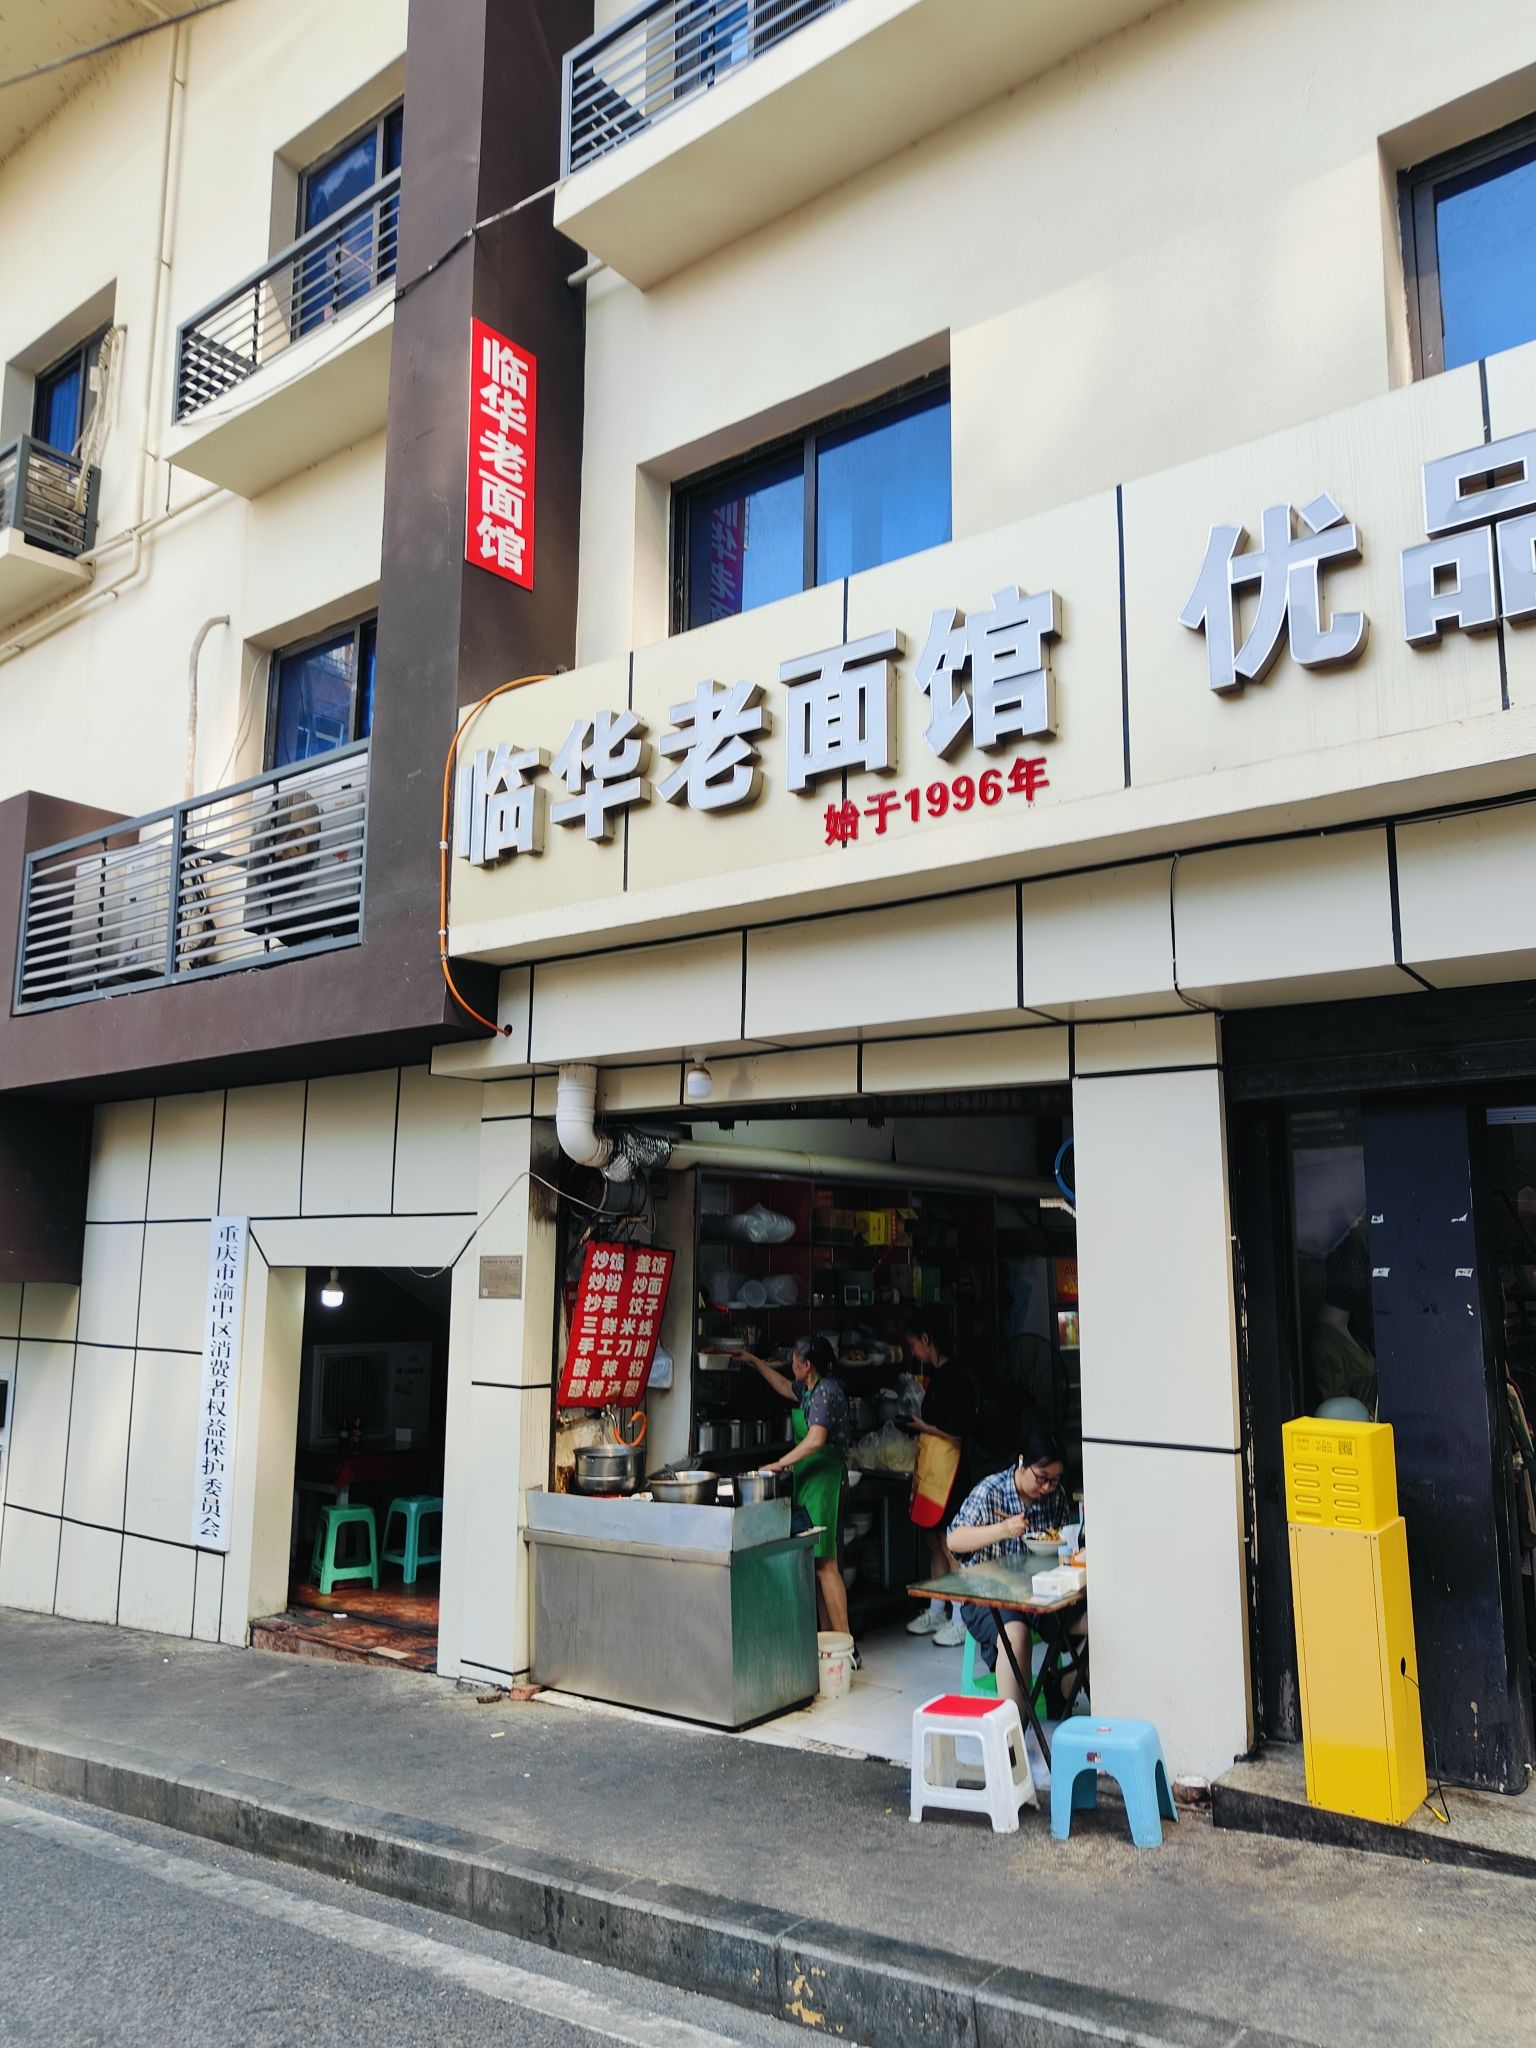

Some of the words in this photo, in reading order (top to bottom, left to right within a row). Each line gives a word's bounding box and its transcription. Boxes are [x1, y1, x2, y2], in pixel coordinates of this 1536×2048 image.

[476, 336, 528, 575] 临华老面馆
[457, 585, 1062, 867] 临华老面馆
[823, 757, 1050, 846] 始于1996年
[591, 1250, 625, 1271] 炒饭
[635, 1254, 667, 1274] 盖饭
[587, 1271, 622, 1292] 炒粉
[631, 1275, 663, 1295] 炒面
[583, 1293, 618, 1314] 抄手
[628, 1296, 659, 1316] 饺子
[580, 1315, 653, 1336] 三鲜米线
[577, 1336, 650, 1358] 手工刀削
[200, 1224, 240, 1539] 重庆市渝中区消费者权益保护委员会
